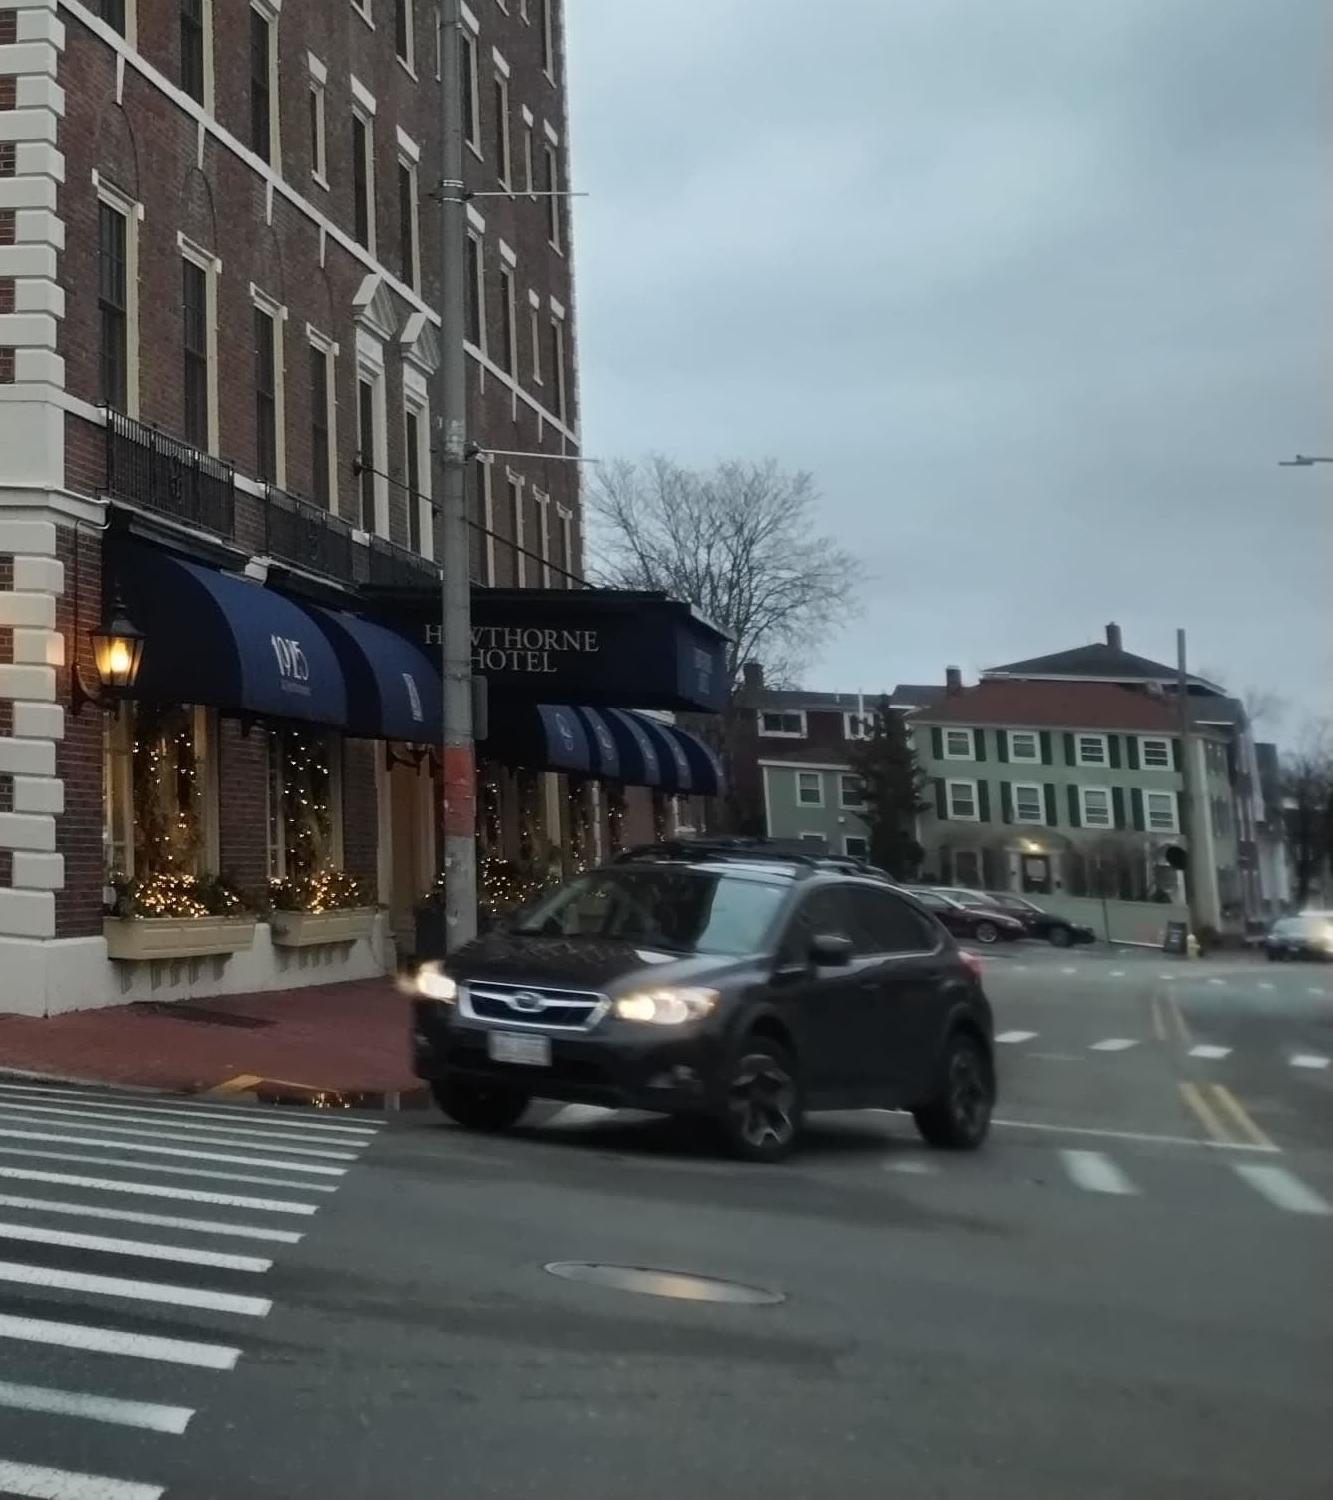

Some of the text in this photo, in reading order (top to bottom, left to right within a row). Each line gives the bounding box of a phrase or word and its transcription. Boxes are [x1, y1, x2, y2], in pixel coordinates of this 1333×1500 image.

[425, 624, 599, 652] HWTHORNE
[270, 634, 309, 681] 1925
[471, 649, 557, 673] HOTEL
